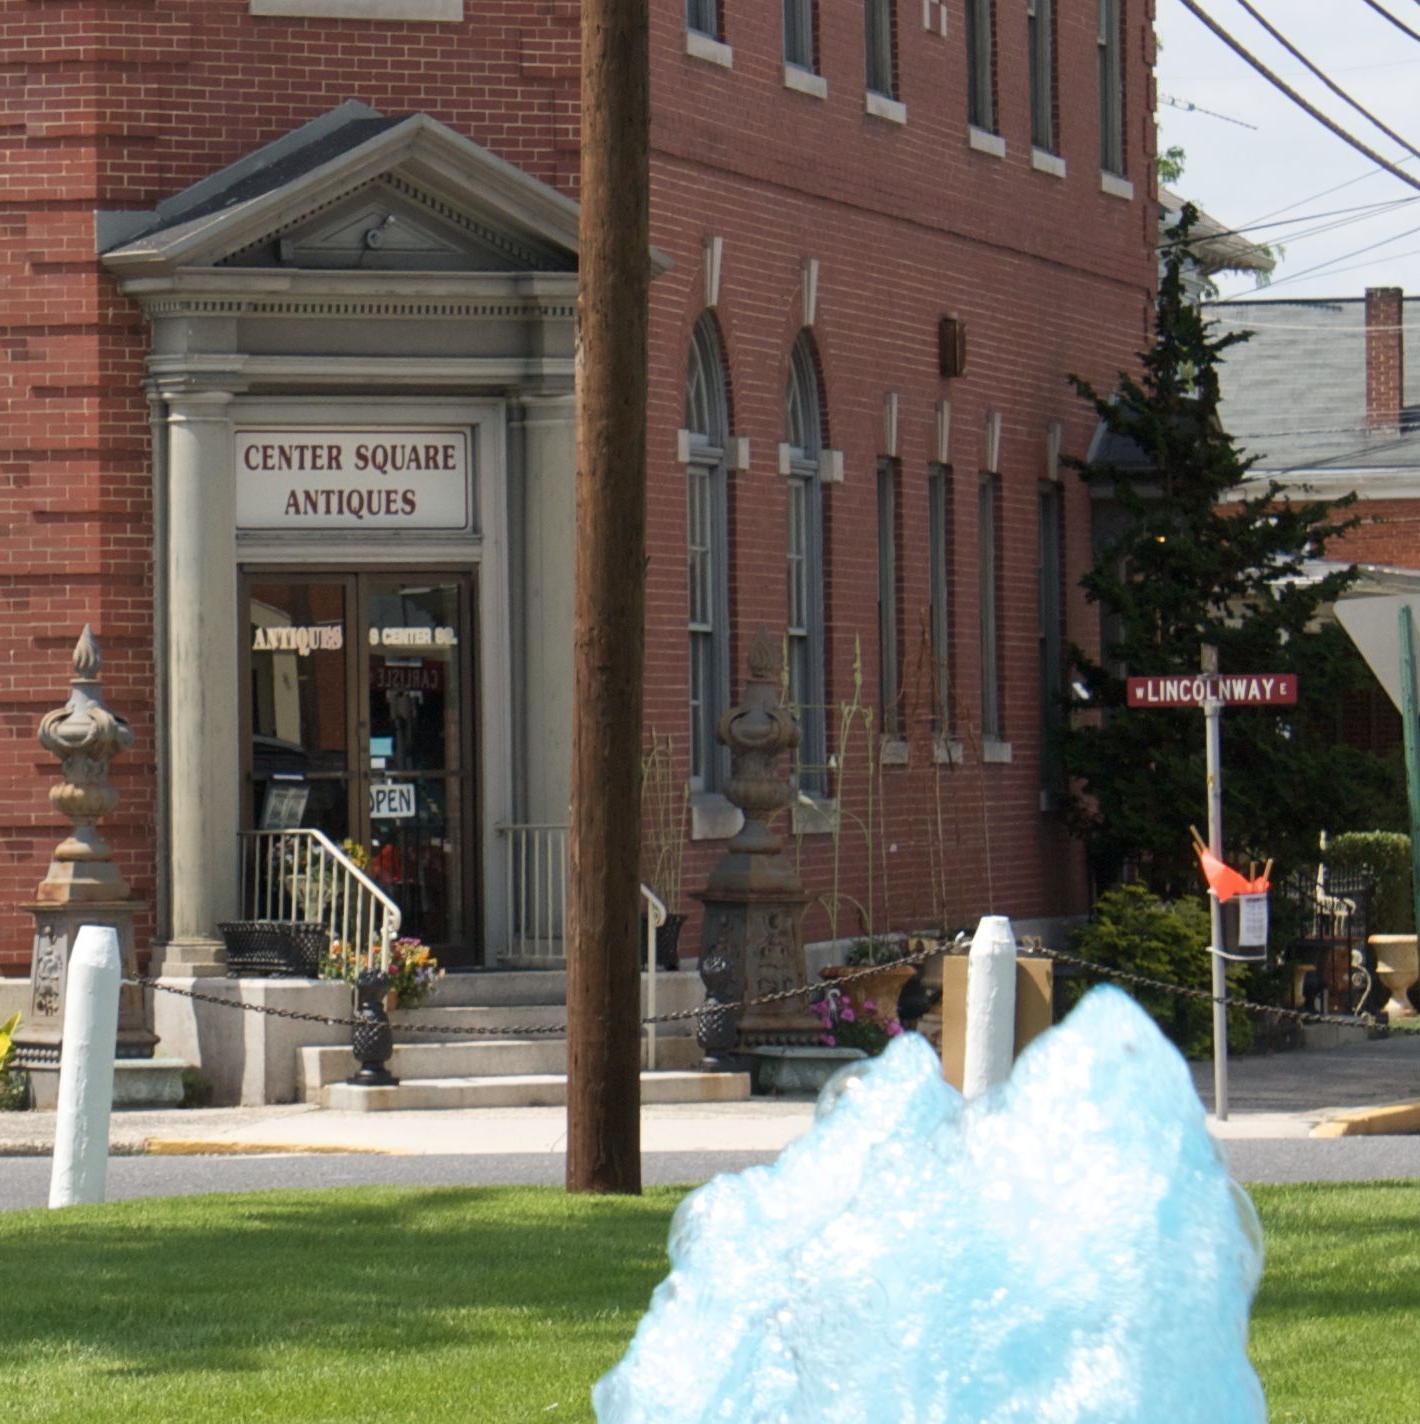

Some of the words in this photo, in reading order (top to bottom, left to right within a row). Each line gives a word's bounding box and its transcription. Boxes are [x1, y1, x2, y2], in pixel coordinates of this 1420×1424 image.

[243, 444, 343, 471] CENTER
[354, 444, 457, 475] SQUARE
[284, 488, 416, 520] ANTIQUES
[252, 625, 343, 657] ANTIQUES
[381, 627, 432, 645] CENTER
[1135, 687, 1144, 699] W
[1147, 678, 1274, 702] LINCOLNWAY
[1279, 682, 1288, 695] E
